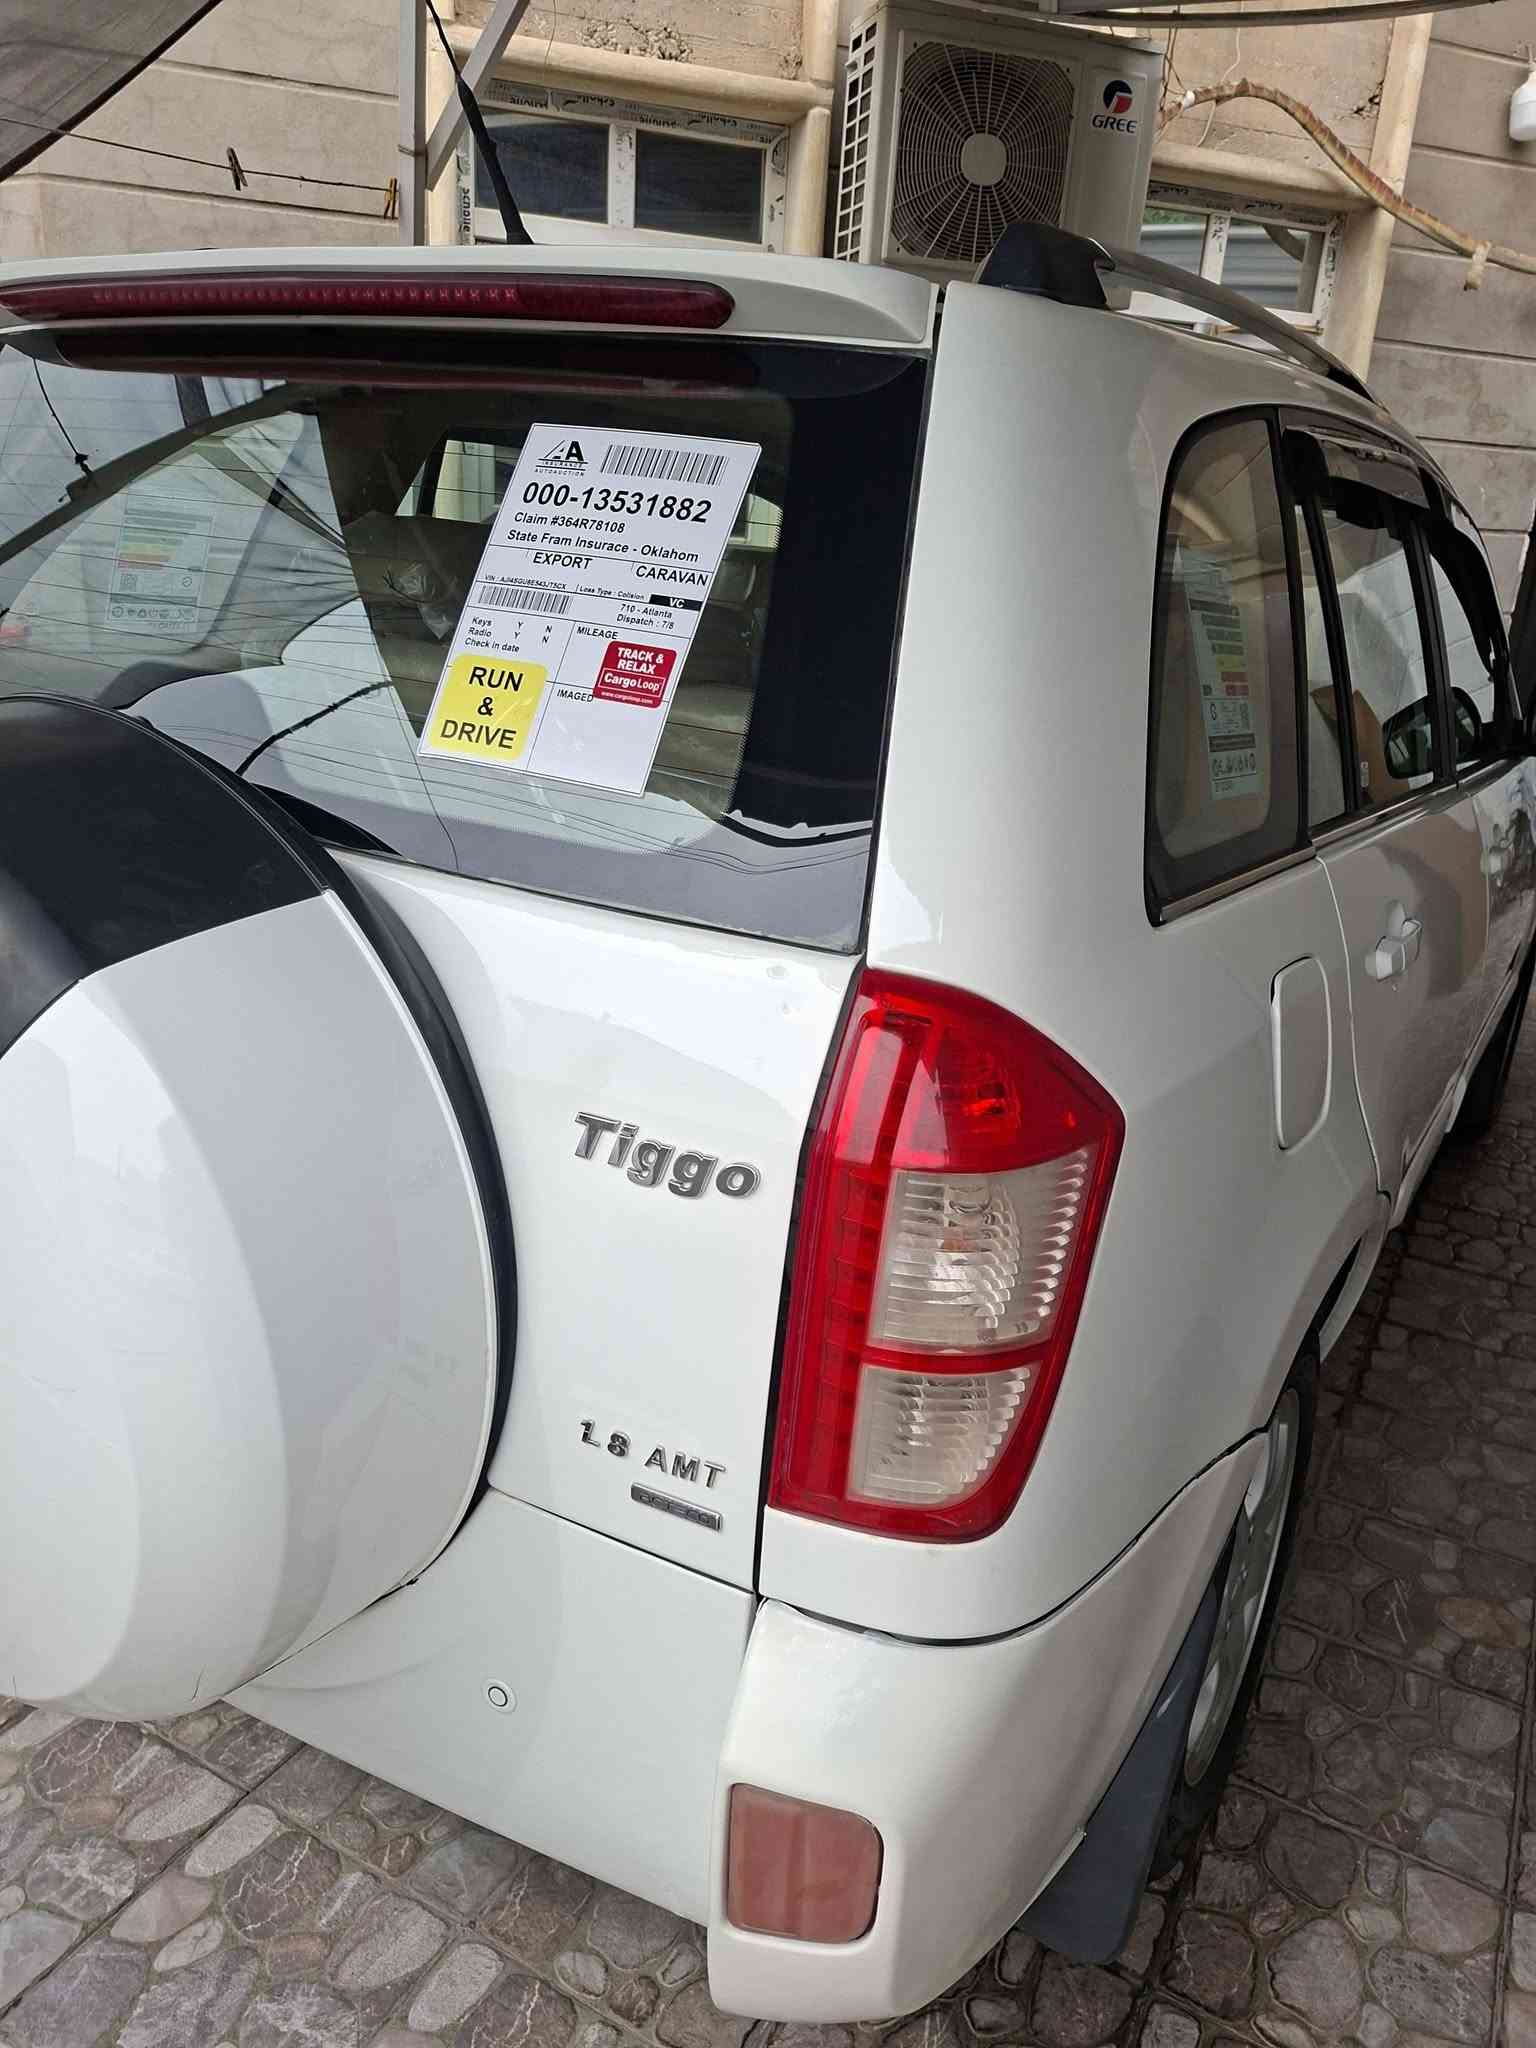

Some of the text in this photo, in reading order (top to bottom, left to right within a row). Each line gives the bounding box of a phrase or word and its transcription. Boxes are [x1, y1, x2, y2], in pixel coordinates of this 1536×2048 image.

[1092, 114, 1137, 134] GREE
[522, 482, 712, 523] 000-13531882
[514, 512, 626, 534] Claim #364R78108
[507, 529, 538, 543] State
[540, 533, 572, 547] Fram
[575, 537, 629, 553] Insurace
[640, 544, 699, 563] Oklahom
[533, 552, 593, 570] EXPORT
[636, 565, 709, 587] CARAVAN
[620, 604, 636, 613] 710
[642, 607, 673, 619] Atlanta
[669, 598, 685, 608] VC
[472, 617, 492, 627] Keys
[546, 625, 552, 633] N
[617, 614, 654, 627] Dispatch
[468, 627, 492, 637] Radio
[514, 631, 520, 639] Y
[576, 626, 618, 640] MILEAGE
[464, 637, 490, 648] Check
[501, 643, 520, 653] date
[617, 647, 664, 664] TRACK &
[617, 659, 656, 675] RELAX
[469, 666, 523, 691] RUN
[557, 689, 594, 703] IMAGED
[477, 697, 493, 716] &
[440, 719, 517, 749] DRIVE
[574, 1111, 762, 1199] Tiggo
[644, 1444, 727, 1489] AMT
